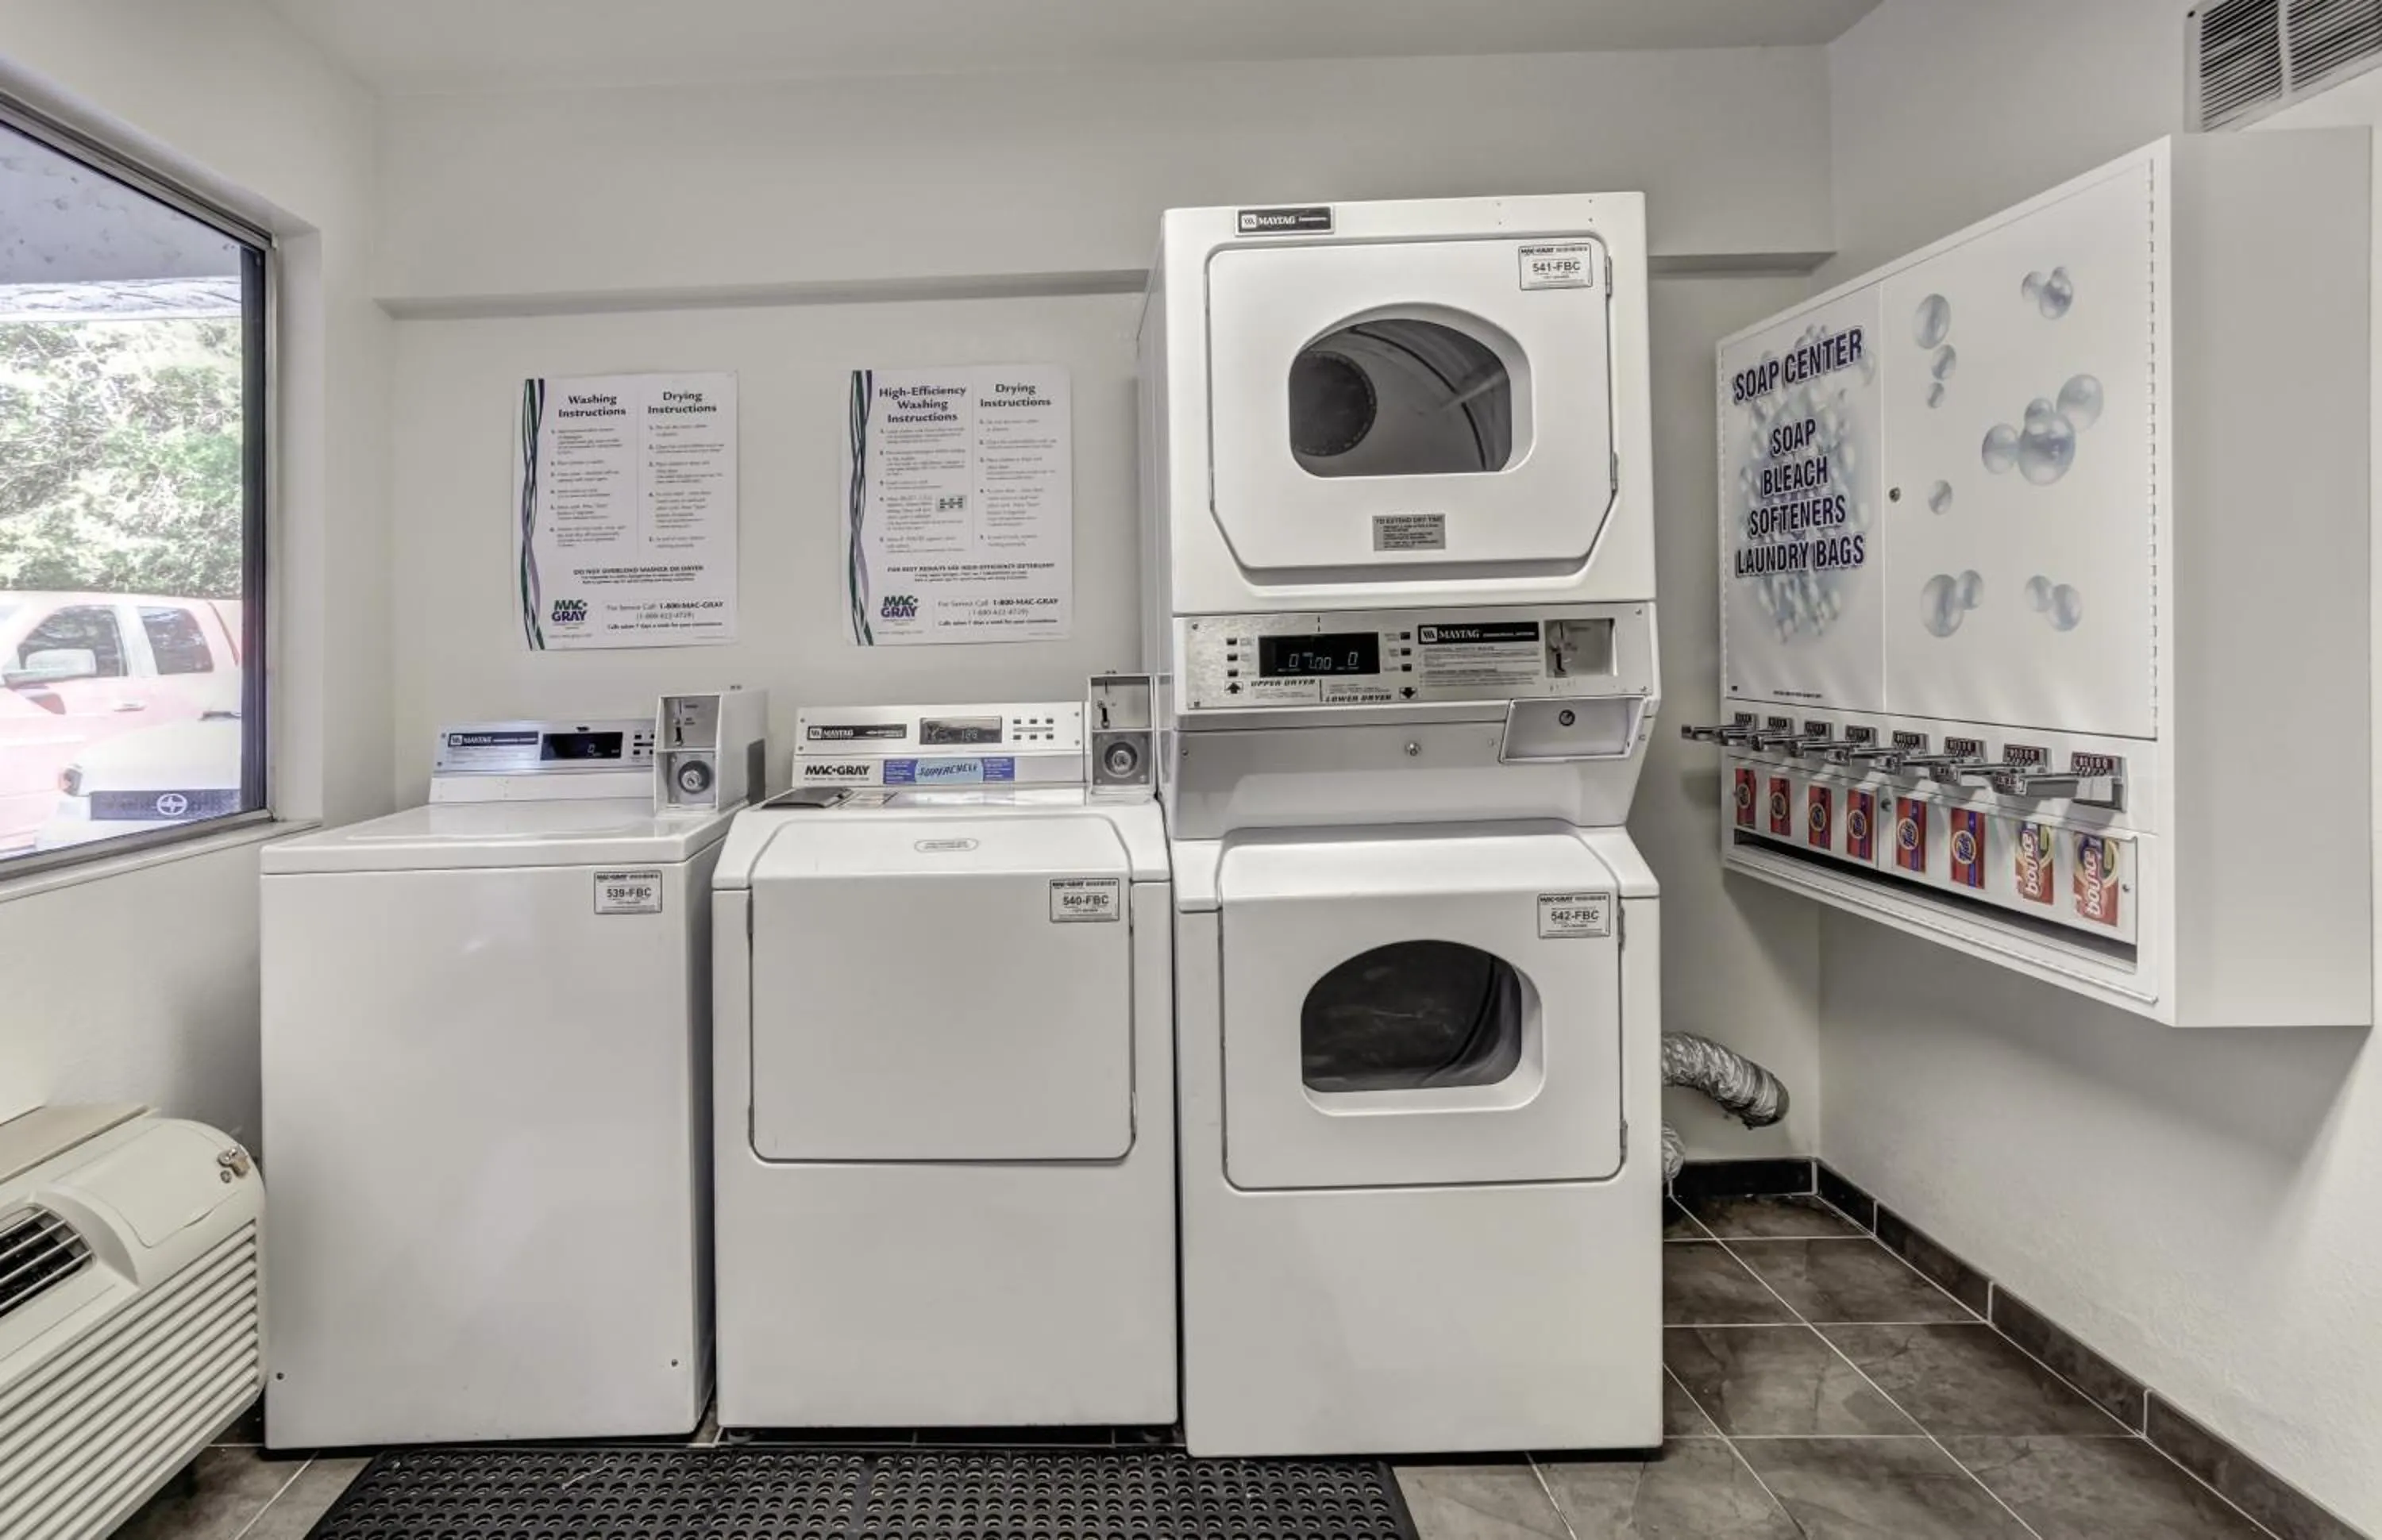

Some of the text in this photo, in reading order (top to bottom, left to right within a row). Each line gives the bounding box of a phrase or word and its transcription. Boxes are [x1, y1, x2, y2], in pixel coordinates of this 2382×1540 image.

[1258, 216, 1296, 225] MAYTAG
[1532, 261, 1581, 271] 541-FBC
[1735, 328, 1863, 402] SOAP CENTER
[879, 385, 966, 399] High-Efficiency
[995, 383, 1036, 395] Drying
[568, 395, 618, 406] Washing
[663, 391, 703, 402] Drying
[980, 398, 1052, 407] Instructions
[647, 403, 717, 414] Instructions
[897, 399, 948, 411] Washing
[558, 407, 626, 418] Instructions
[887, 414, 958, 423] Instructions
[1772, 418, 1817, 456] SOAP
[1763, 456, 1828, 496] BLEACH
[1750, 495, 1846, 536] SOFTENERS
[1737, 534, 1865, 575] LAUNDRY BAGS
[551, 610, 588, 622] GRAY
[881, 606, 918, 618] GRAY
[1439, 629, 1480, 639] MAYTAG
[2024, 833, 2040, 896] bounce
[2084, 848, 2102, 917] bounce
[1063, 895, 1108, 905] 540-FBC
[1551, 911, 1599, 921] 542-FBC
